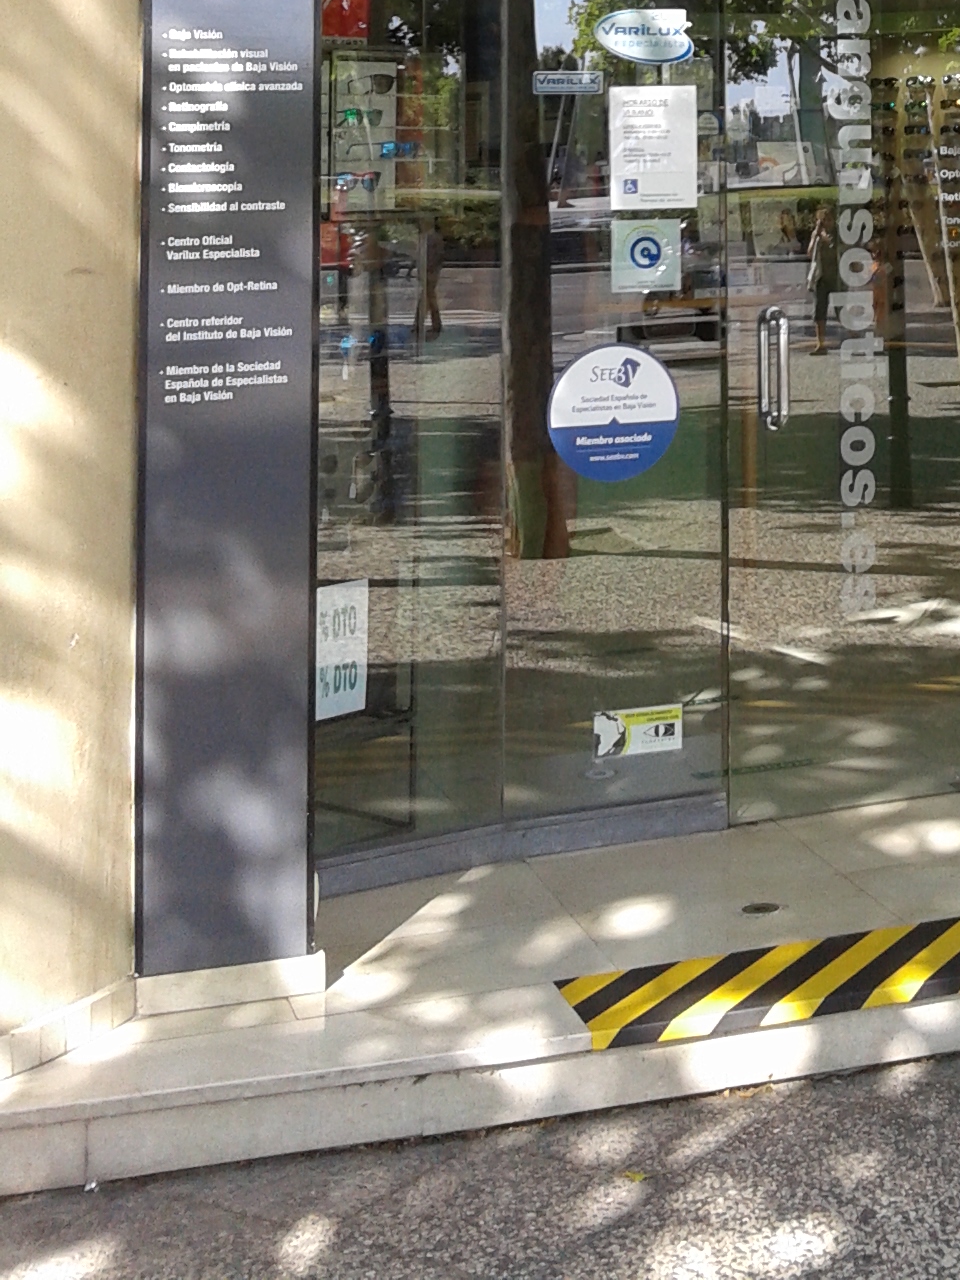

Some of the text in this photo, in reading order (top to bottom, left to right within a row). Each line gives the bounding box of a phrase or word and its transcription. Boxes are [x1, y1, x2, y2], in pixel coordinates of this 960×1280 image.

[193, 29, 223, 39] Visión
[240, 48, 268, 58] visual
[168, 63, 180, 72] en
[231, 62, 243, 72] de
[246, 62, 267, 74] Baja
[269, 61, 298, 72] Visión
[169, 80, 223, 94] Optometría
[258, 81, 303, 92] avanzada
[168, 141, 223, 153] Tonometría
[168, 200, 286, 213] Sensibilidad al contraste
[168, 235, 232, 247] Centro Oficial
[167, 248, 260, 261] Varilux Especialista
[167, 280, 278, 294] Miembro de Opt-Retina
[167, 316, 244, 328] Centro referidor
[166, 326, 293, 342] del Instituto de Baja Visión
[166, 360, 281, 376] Miembro de la Sociedad
[165, 374, 289, 391] Española de Especialistas
[164, 390, 234, 404] en Baja Visión
[581, 395, 610, 403] Sociedad
[611, 394, 639, 403] Española
[572, 404, 613, 413] Especialistas
[623, 403, 637, 411] Baja
[576, 432, 653, 446] Miembro asociado
[332, 605, 357, 639] DTO
[333, 660, 358, 695] DTO
